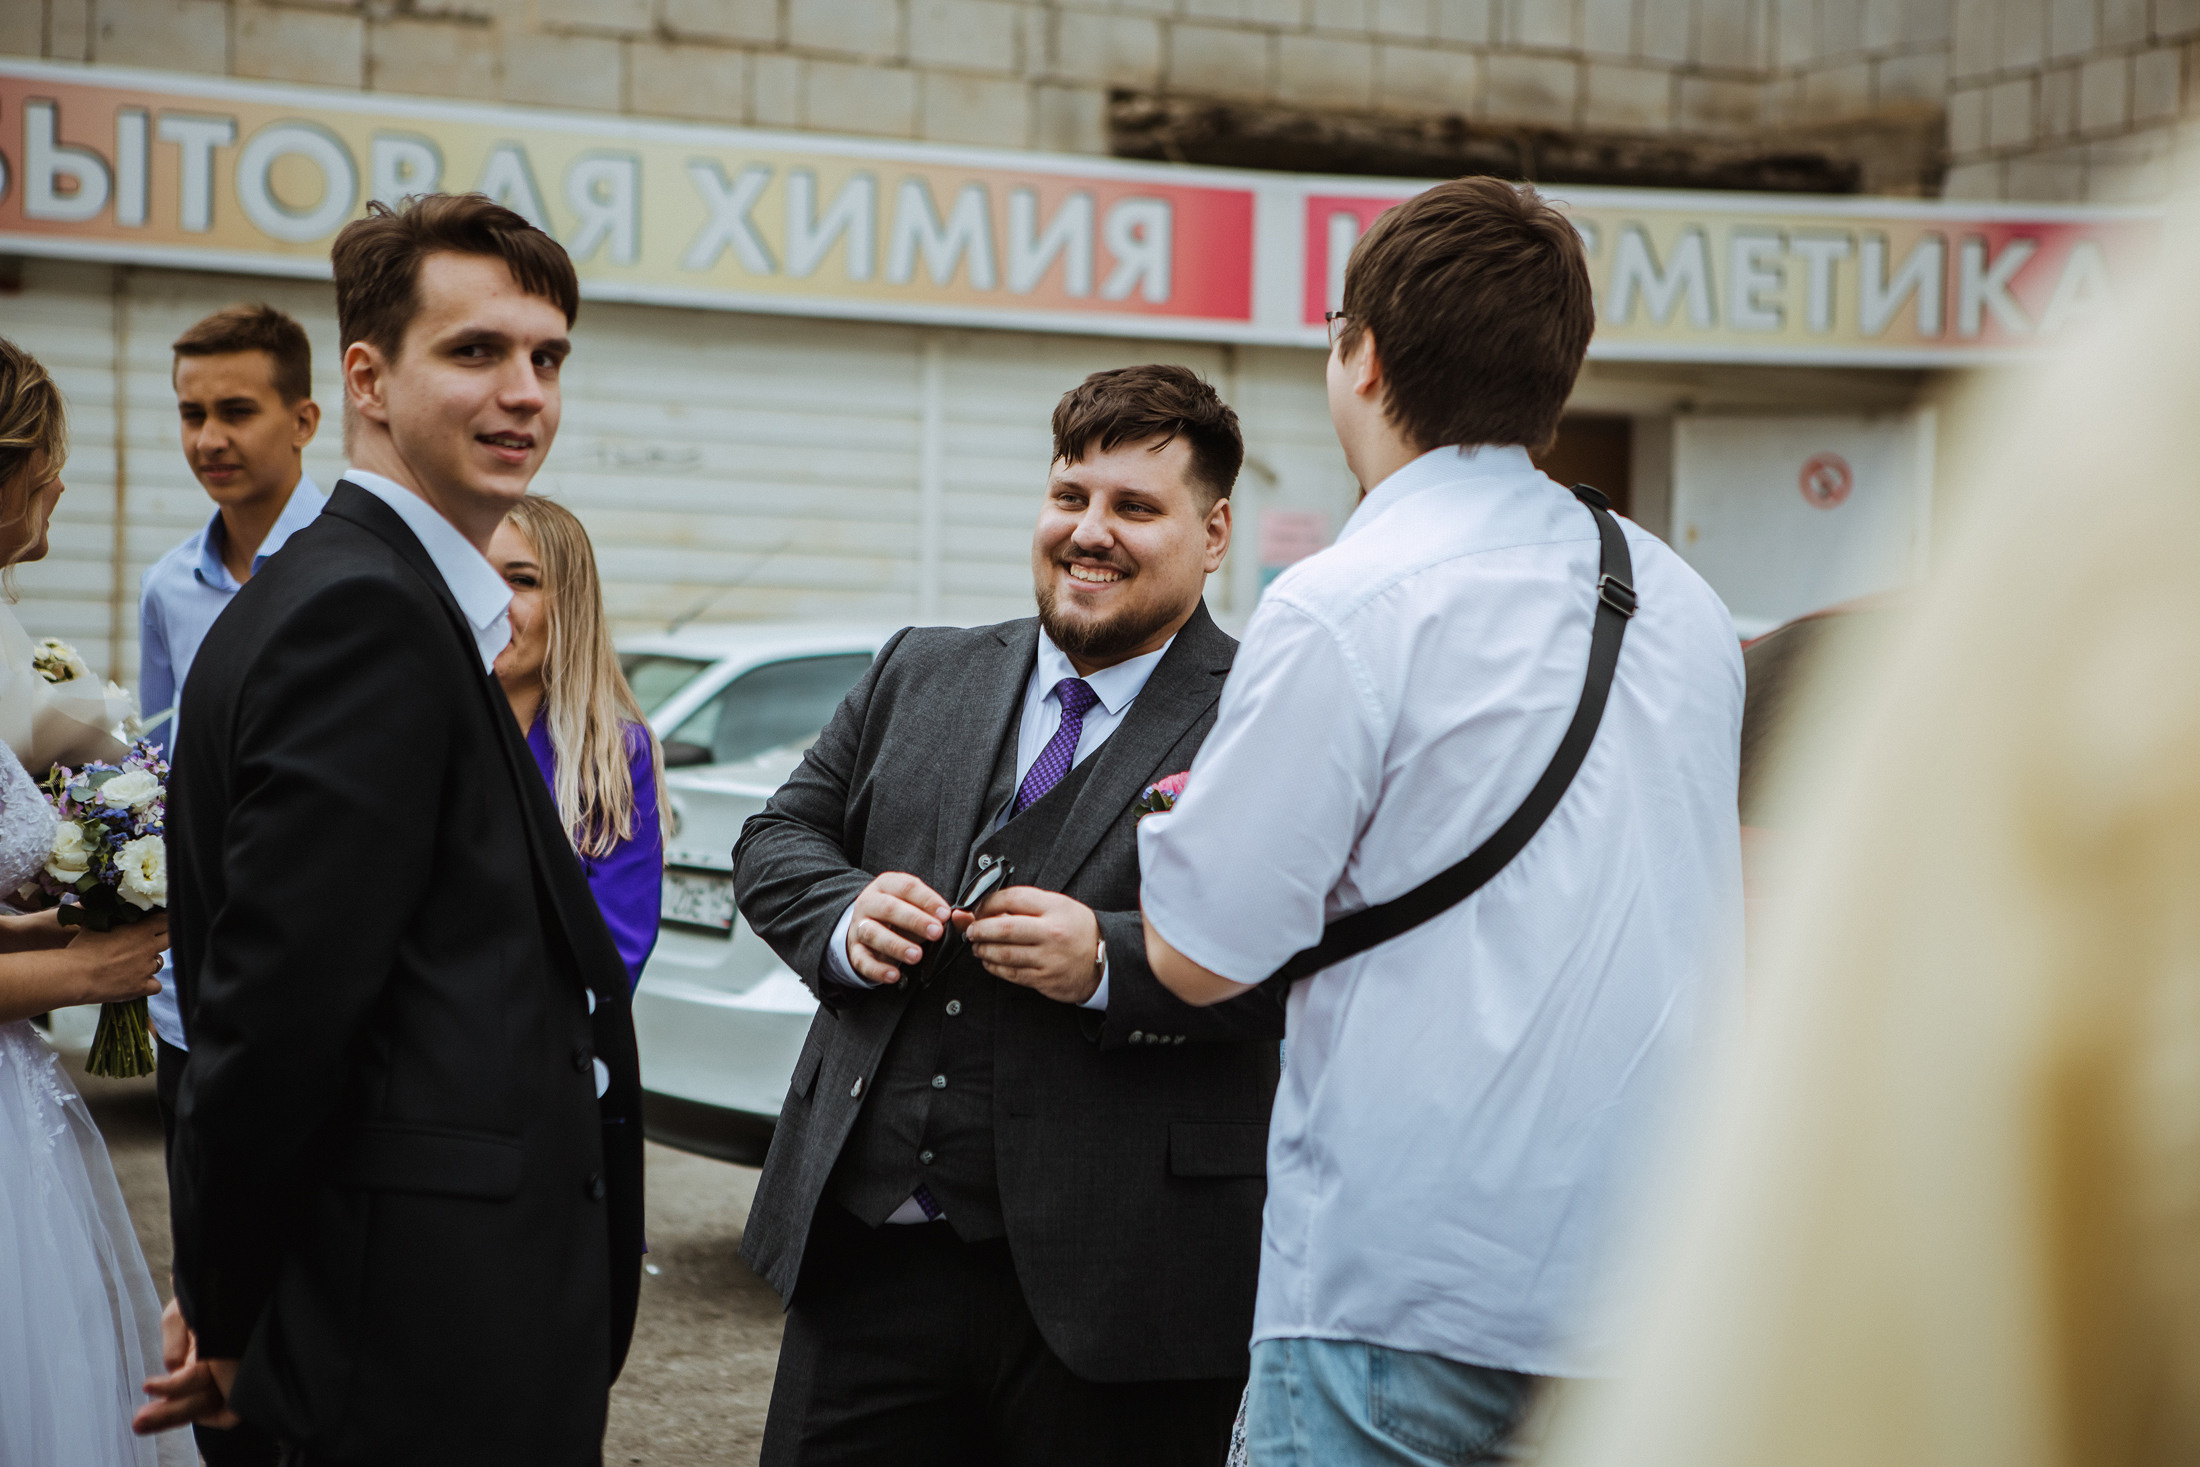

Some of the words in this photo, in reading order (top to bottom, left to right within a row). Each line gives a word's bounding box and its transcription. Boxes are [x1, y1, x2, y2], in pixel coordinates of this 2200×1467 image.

[0, 96, 642, 266] ЫТОВАЯ
[682, 156, 1172, 304] ХИМИЯ
[1327, 209, 2122, 340] МЕТИКА
